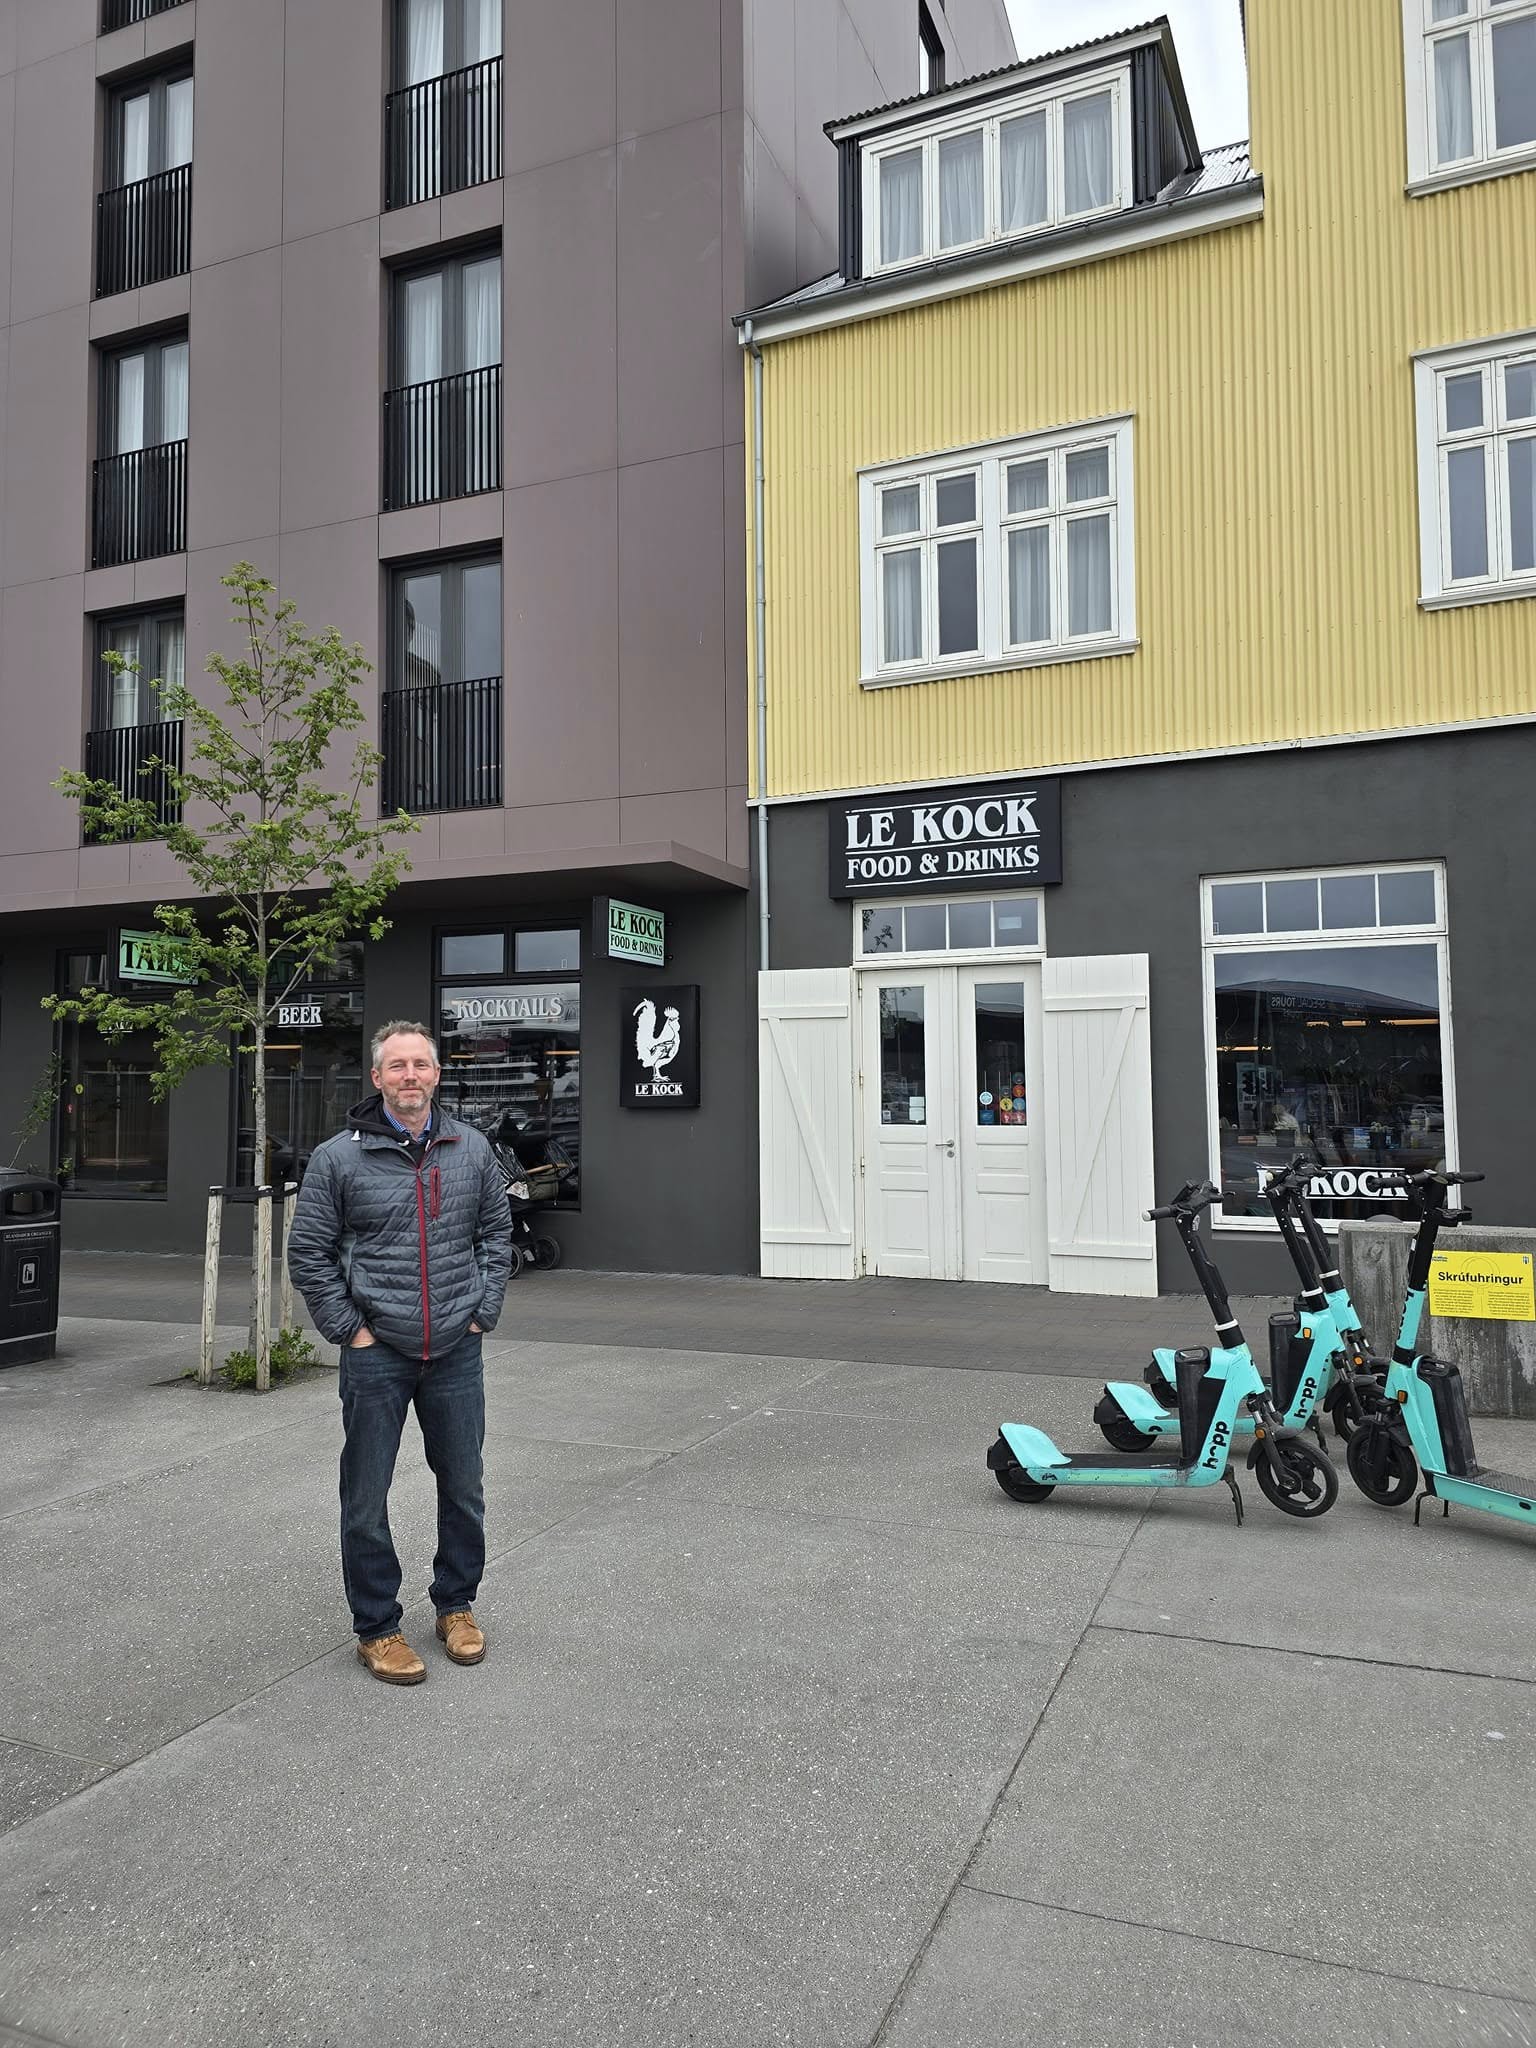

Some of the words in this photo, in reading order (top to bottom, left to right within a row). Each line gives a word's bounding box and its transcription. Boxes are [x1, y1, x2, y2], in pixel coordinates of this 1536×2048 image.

[846, 811, 897, 849] LE
[911, 797, 1041, 844] KOCK
[847, 855, 912, 879] FOOD
[919, 853, 940, 875] &
[946, 845, 1041, 873] DRINKS
[610, 909, 626, 930] LE
[630, 914, 663, 939] KOCK
[610, 934, 630, 949] FOOD
[632, 939, 639, 952] &
[639, 940, 663, 957] DRINKS
[278, 1006, 323, 1025] BEER
[456, 997, 562, 1019] KOCKTAILS
[635, 1084, 649, 1095] LE
[652, 1084, 684, 1096] KOCK
[1438, 1271, 1524, 1287] Skrúfuhringur
